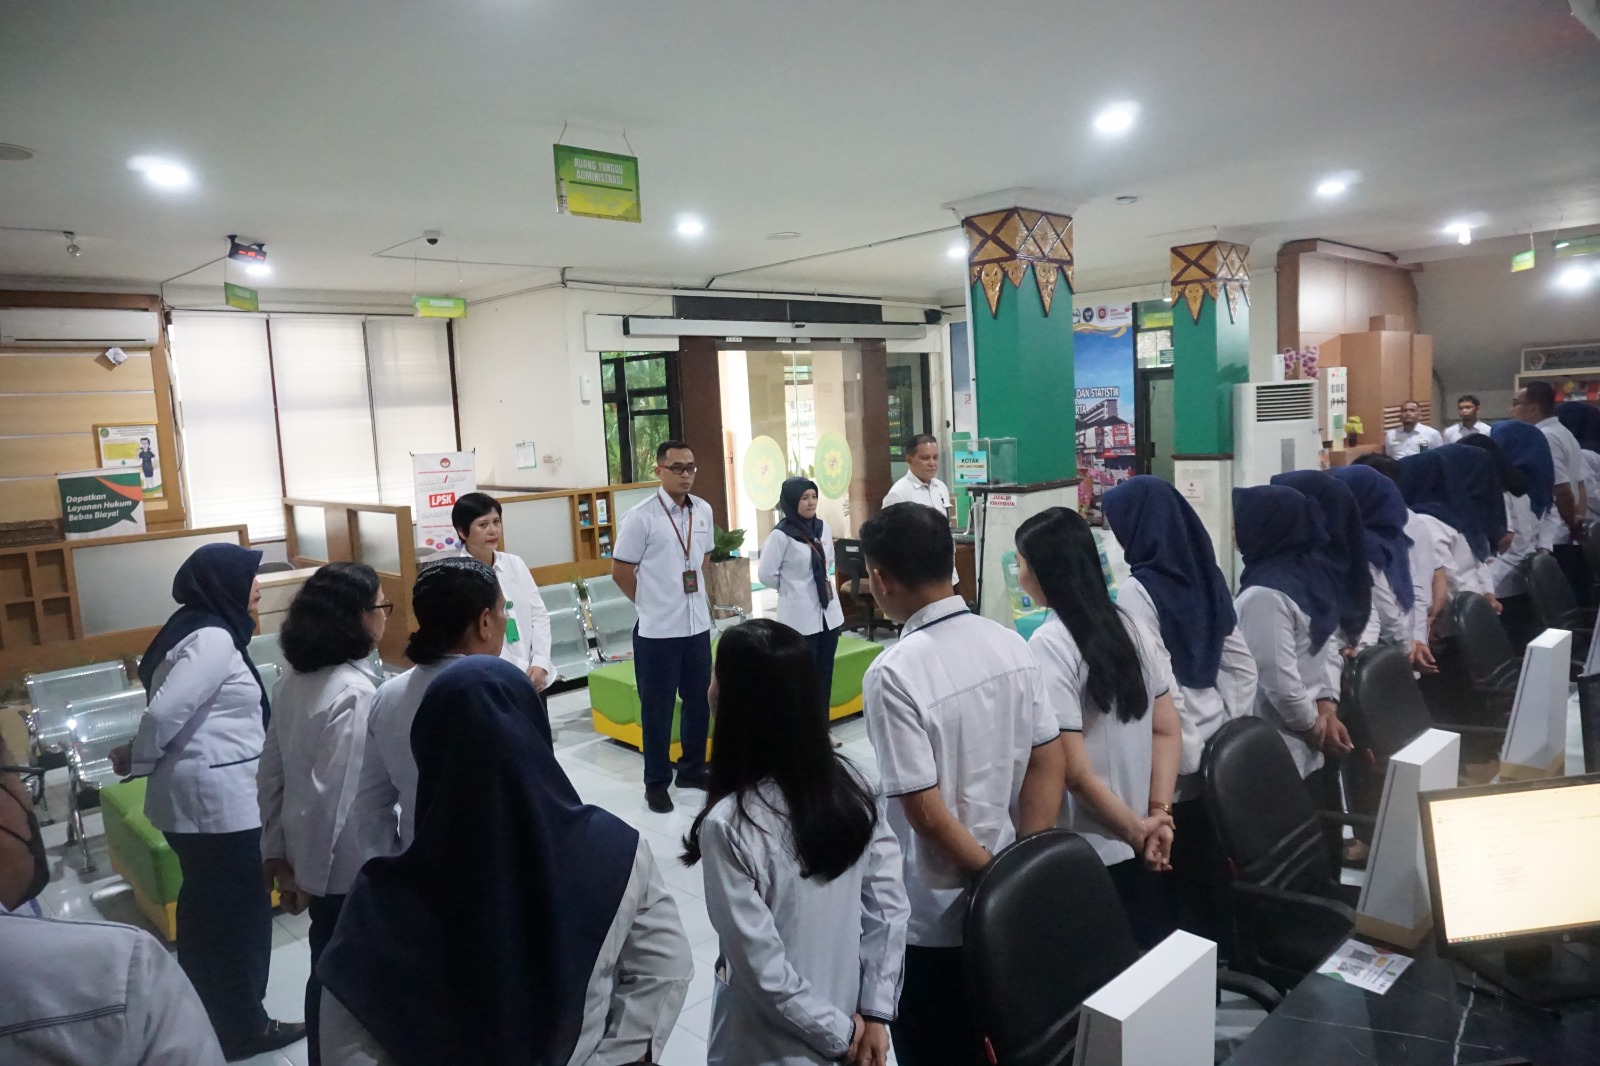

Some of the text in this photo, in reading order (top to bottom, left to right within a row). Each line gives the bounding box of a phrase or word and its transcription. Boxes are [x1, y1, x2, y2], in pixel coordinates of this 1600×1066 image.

[574, 158, 623, 174] RUANG TUNGGU
[576, 170, 623, 185] ADMINISTRASI
[1076, 387, 1119, 399] DAN STATISTIK
[66, 494, 106, 503] Dapatkan
[431, 494, 452, 506] LPSK
[67, 500, 132, 513] Layanan Hukum
[69, 510, 119, 522] Bebas Biaya!
